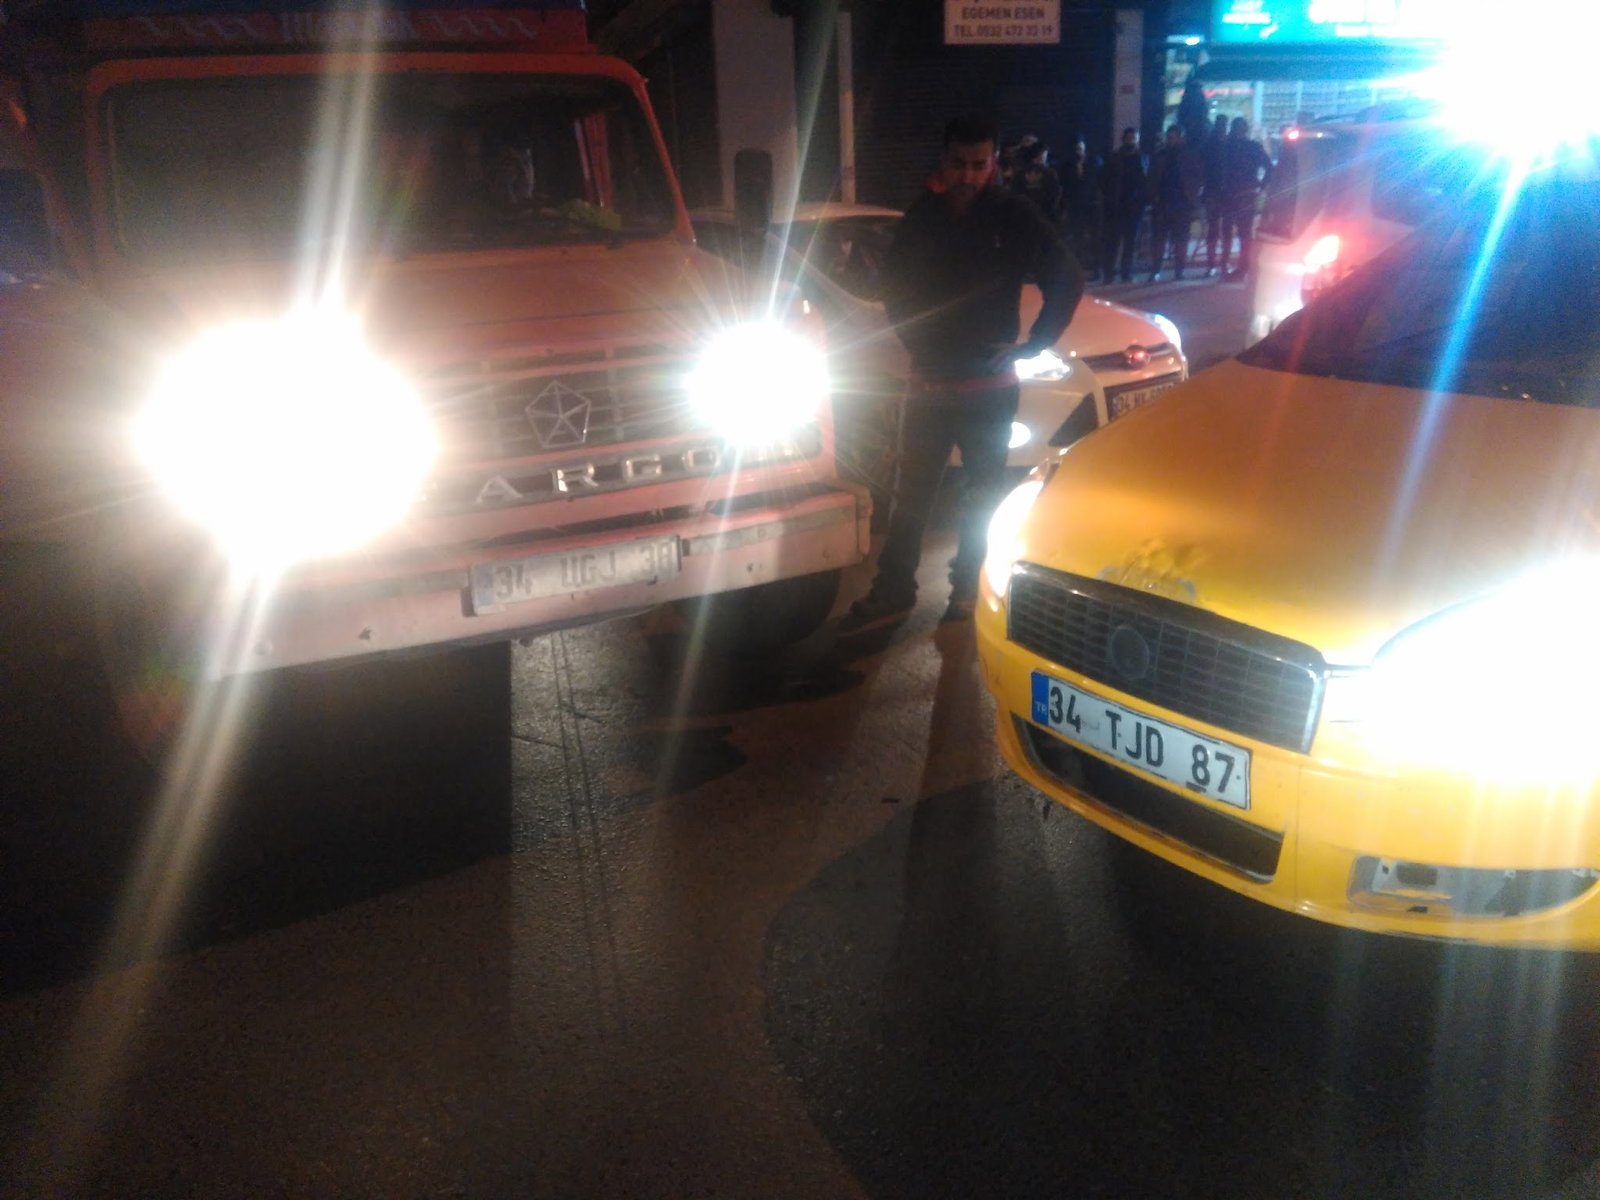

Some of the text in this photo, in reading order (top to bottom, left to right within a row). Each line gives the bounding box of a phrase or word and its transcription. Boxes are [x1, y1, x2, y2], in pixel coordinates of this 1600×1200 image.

[1049, 686, 1235, 793] 34 TJD 87
